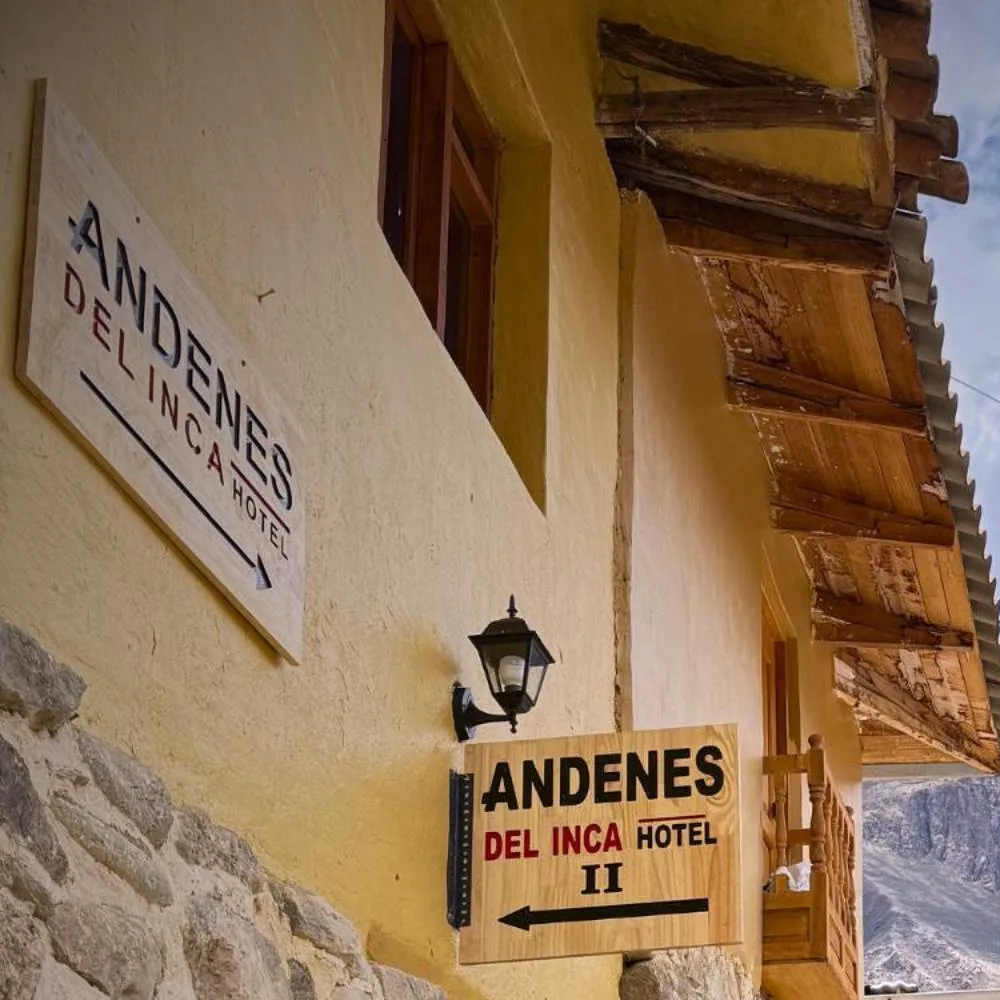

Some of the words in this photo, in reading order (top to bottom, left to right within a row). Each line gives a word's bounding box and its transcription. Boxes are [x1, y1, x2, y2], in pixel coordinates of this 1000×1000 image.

[68, 200, 293, 511] ANDENES
[64, 261, 135, 380] DEL
[148, 365, 225, 486] INCA
[232, 479, 289, 561] HOTEL
[481, 745, 725, 812] ANDENES
[484, 829, 539, 861] DEL
[552, 822, 623, 856] INCA
[637, 821, 717, 850] HOTEL
[581, 862, 623, 894] II
